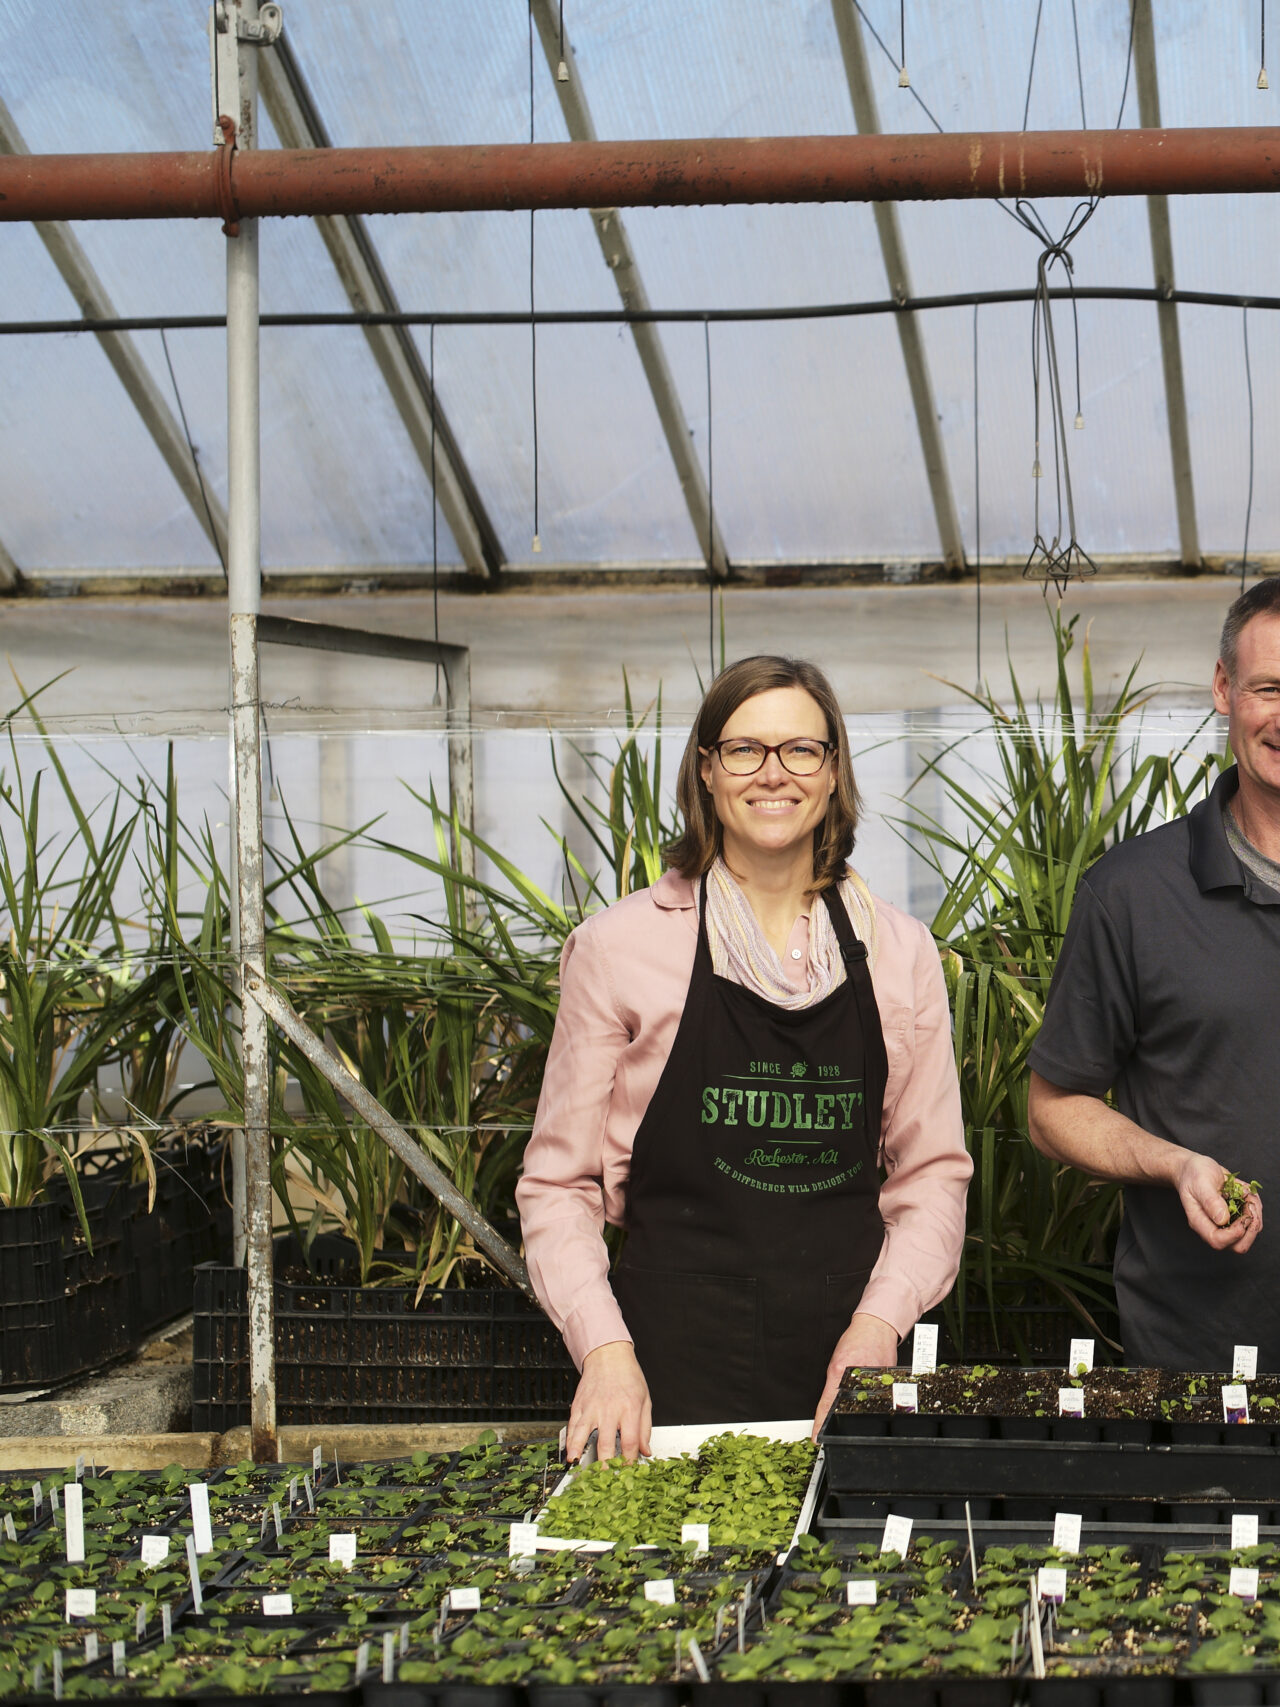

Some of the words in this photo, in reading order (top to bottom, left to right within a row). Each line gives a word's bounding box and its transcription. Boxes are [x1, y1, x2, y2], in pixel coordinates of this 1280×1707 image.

[749, 1061, 782, 1074] SINCE
[817, 1065, 841, 1077] 1928
[701, 1087, 864, 1130] STUDLEY'
[744, 1147, 810, 1168] Rochester,
[812, 1149, 839, 1165] NH
[713, 1157, 731, 1174] THE
[731, 1169, 786, 1193] DIFFERENCE
[788, 1184, 810, 1193] WILL
[811, 1172, 847, 1192] DELIGHT
